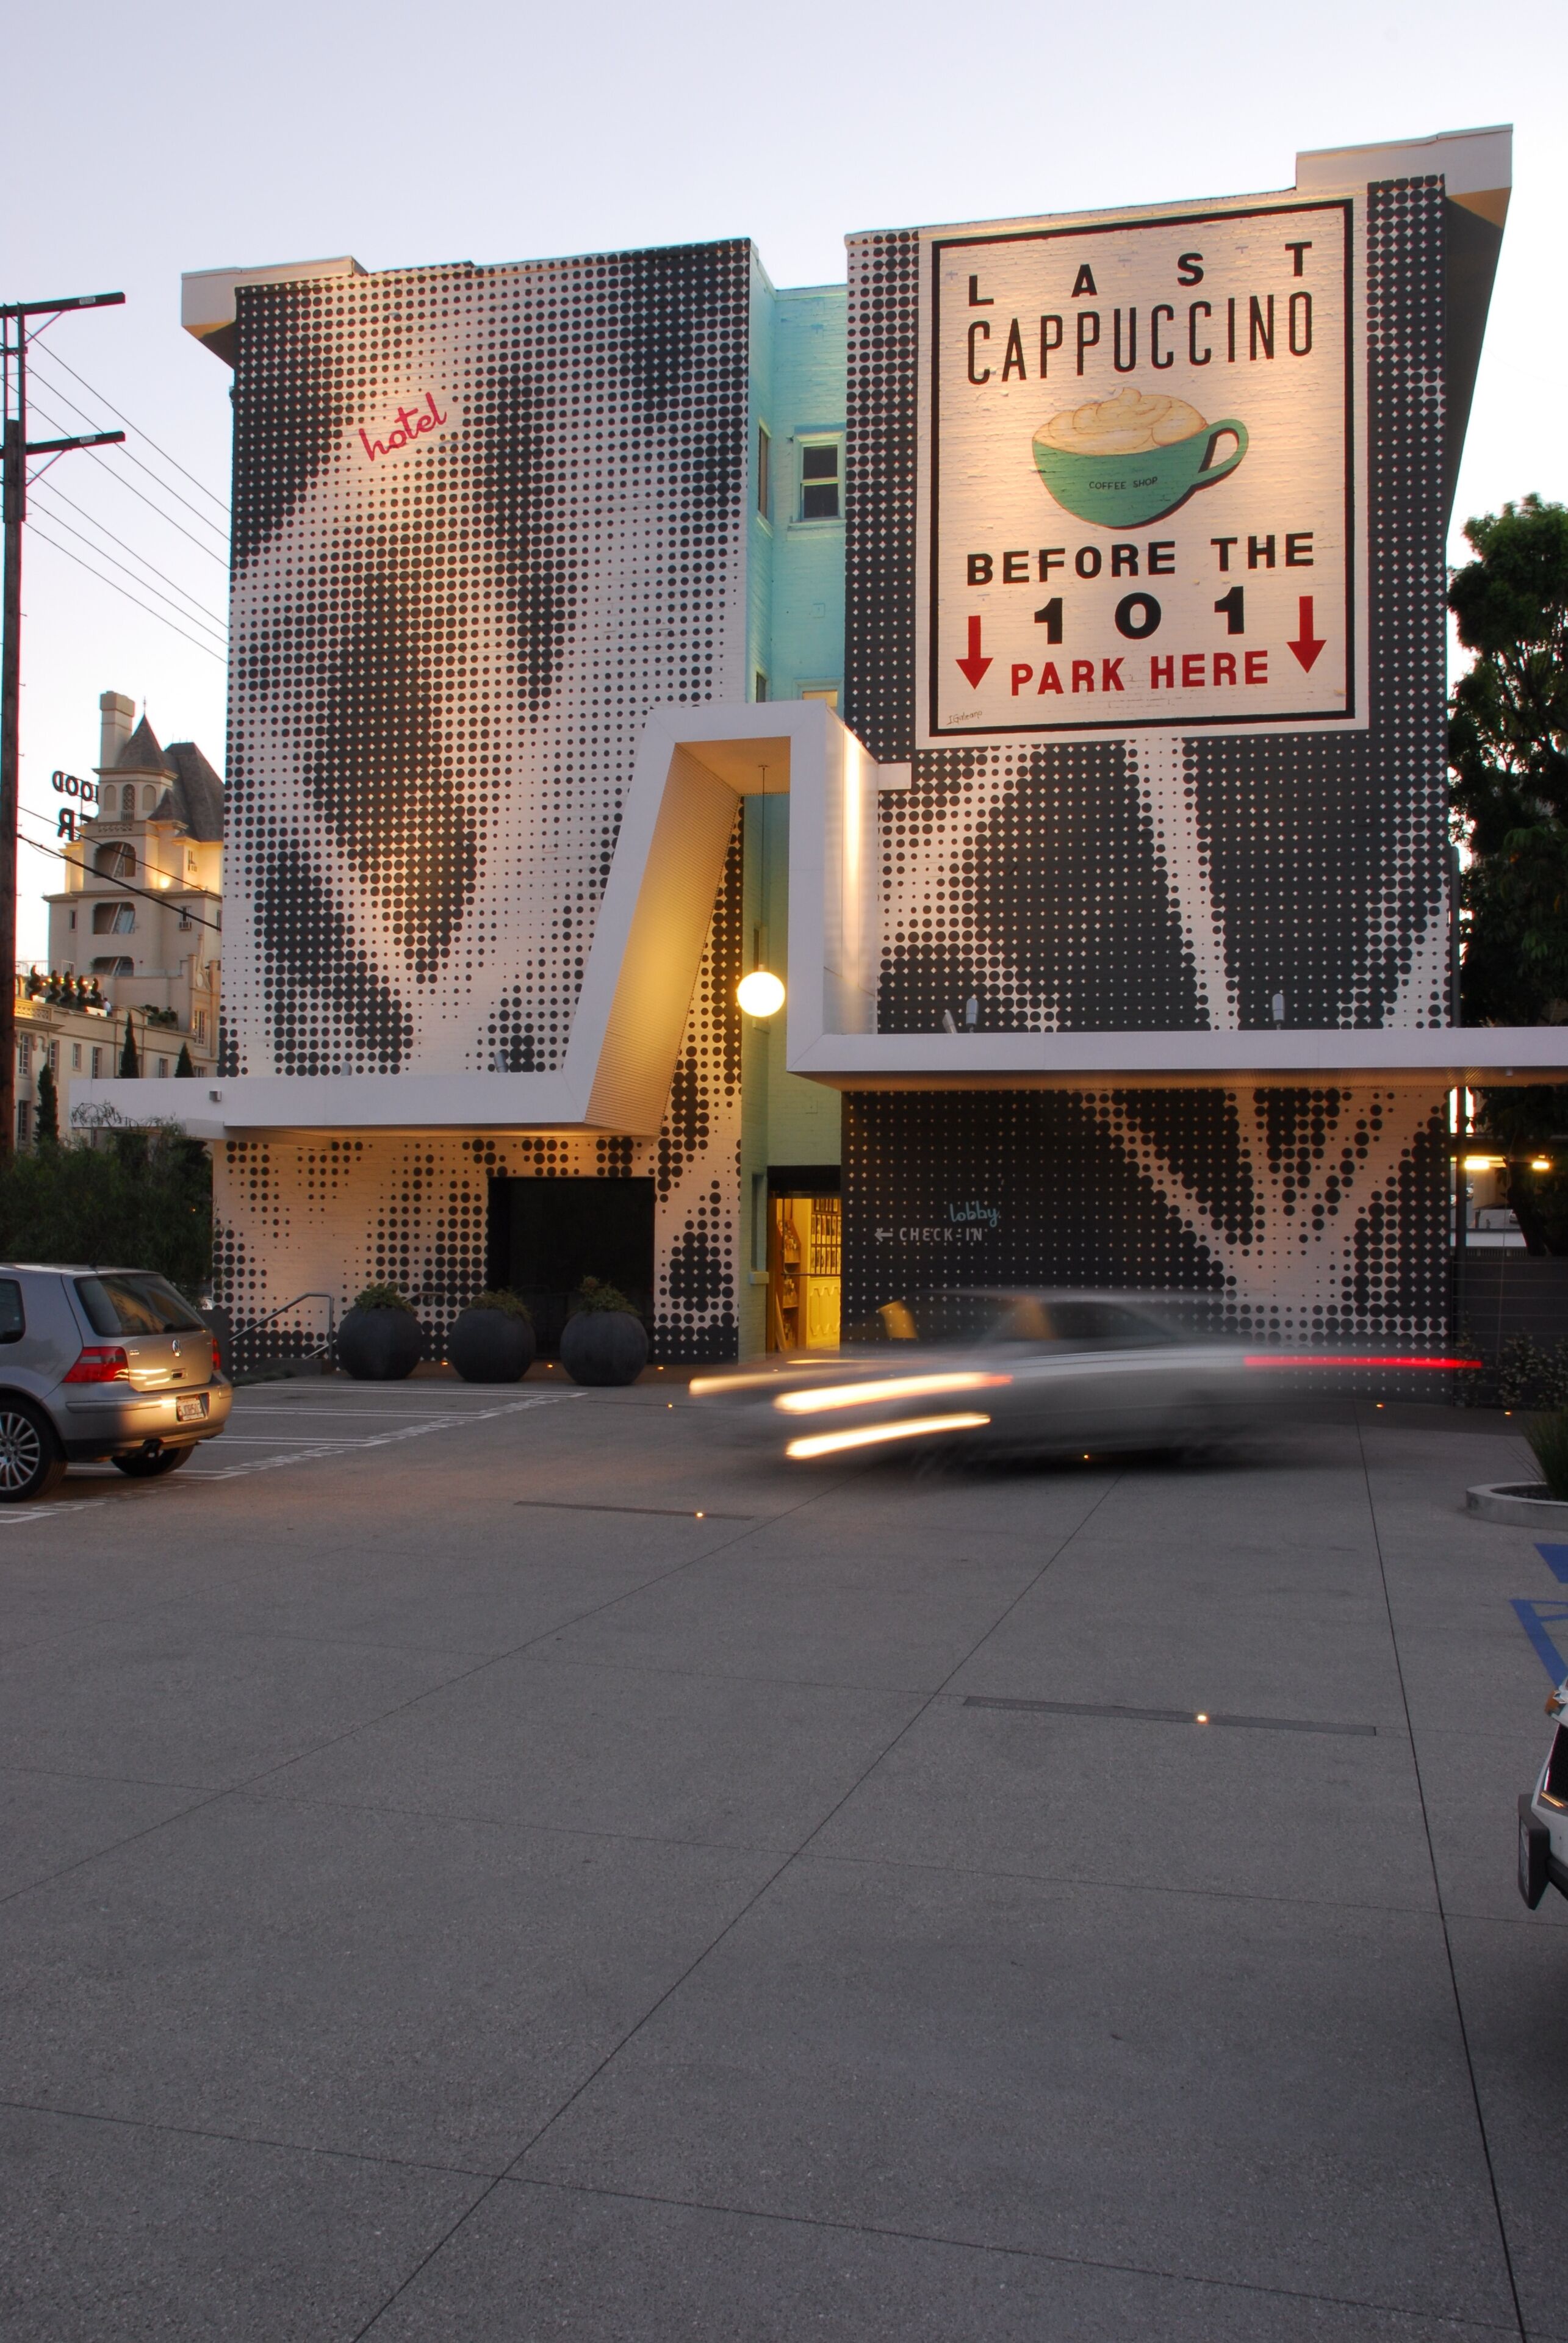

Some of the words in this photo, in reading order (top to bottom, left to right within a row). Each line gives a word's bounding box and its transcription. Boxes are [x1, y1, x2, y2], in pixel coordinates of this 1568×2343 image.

[968, 242, 1312, 306] LAST
[968, 291, 1312, 385] CAPPUCCINO
[358, 392, 447, 461] hotel
[1089, 481, 1126, 490] COFFEE
[1133, 477, 1158, 488] SHOP
[967, 541, 1175, 586] BEFORE
[1210, 532, 1314, 571] THE
[1034, 586, 1244, 644] 101
[1011, 658, 1125, 696] PARK
[1151, 650, 1268, 689] HERE
[899, 1227, 983, 1242] CHECK-IN
[949, 1201, 1000, 1228] lobby
